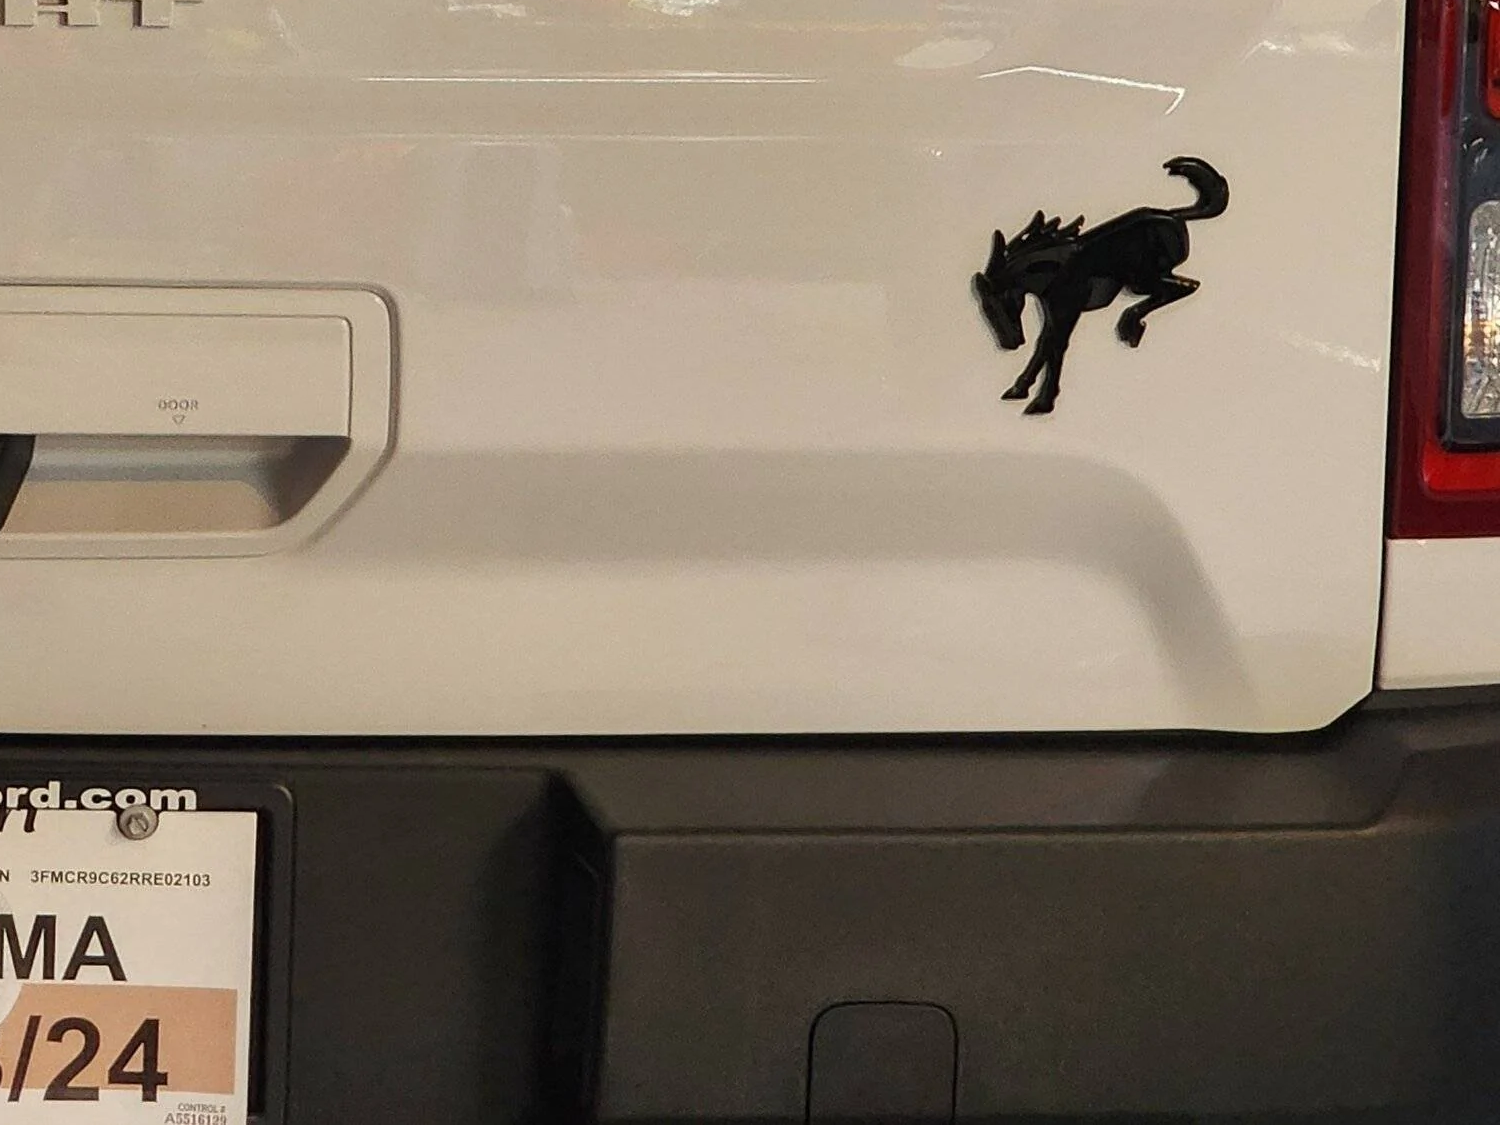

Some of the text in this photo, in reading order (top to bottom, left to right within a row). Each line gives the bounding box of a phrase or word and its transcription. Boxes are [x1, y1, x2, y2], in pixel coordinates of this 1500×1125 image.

[157, 399, 199, 412] DOOR
[30, 870, 212, 887] 3FMCR9C62RRE02103
[177, 1102, 218, 1114] CONTROL
